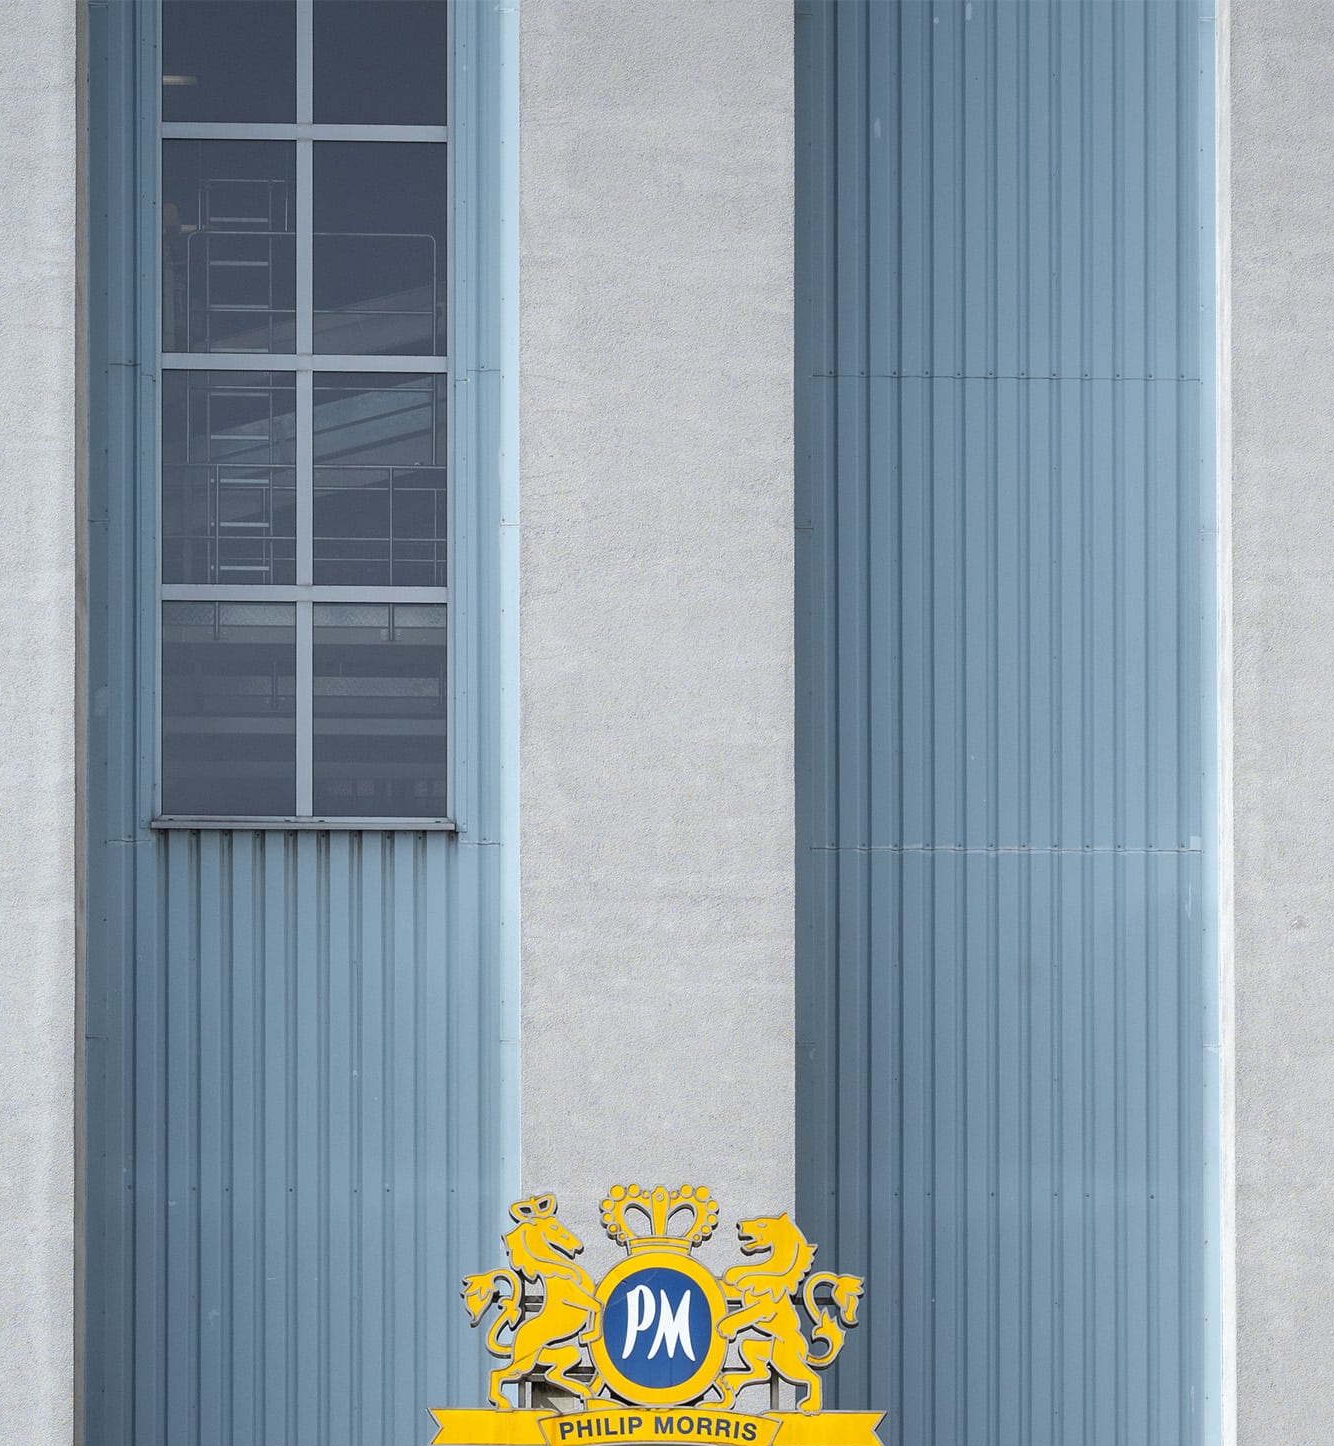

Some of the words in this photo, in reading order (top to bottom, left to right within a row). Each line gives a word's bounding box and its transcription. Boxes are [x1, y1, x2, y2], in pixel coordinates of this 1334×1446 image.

[621, 1284, 696, 1362] PM
[559, 1417, 643, 1441] PHILIP
[654, 1416, 757, 1441] MORRIS
